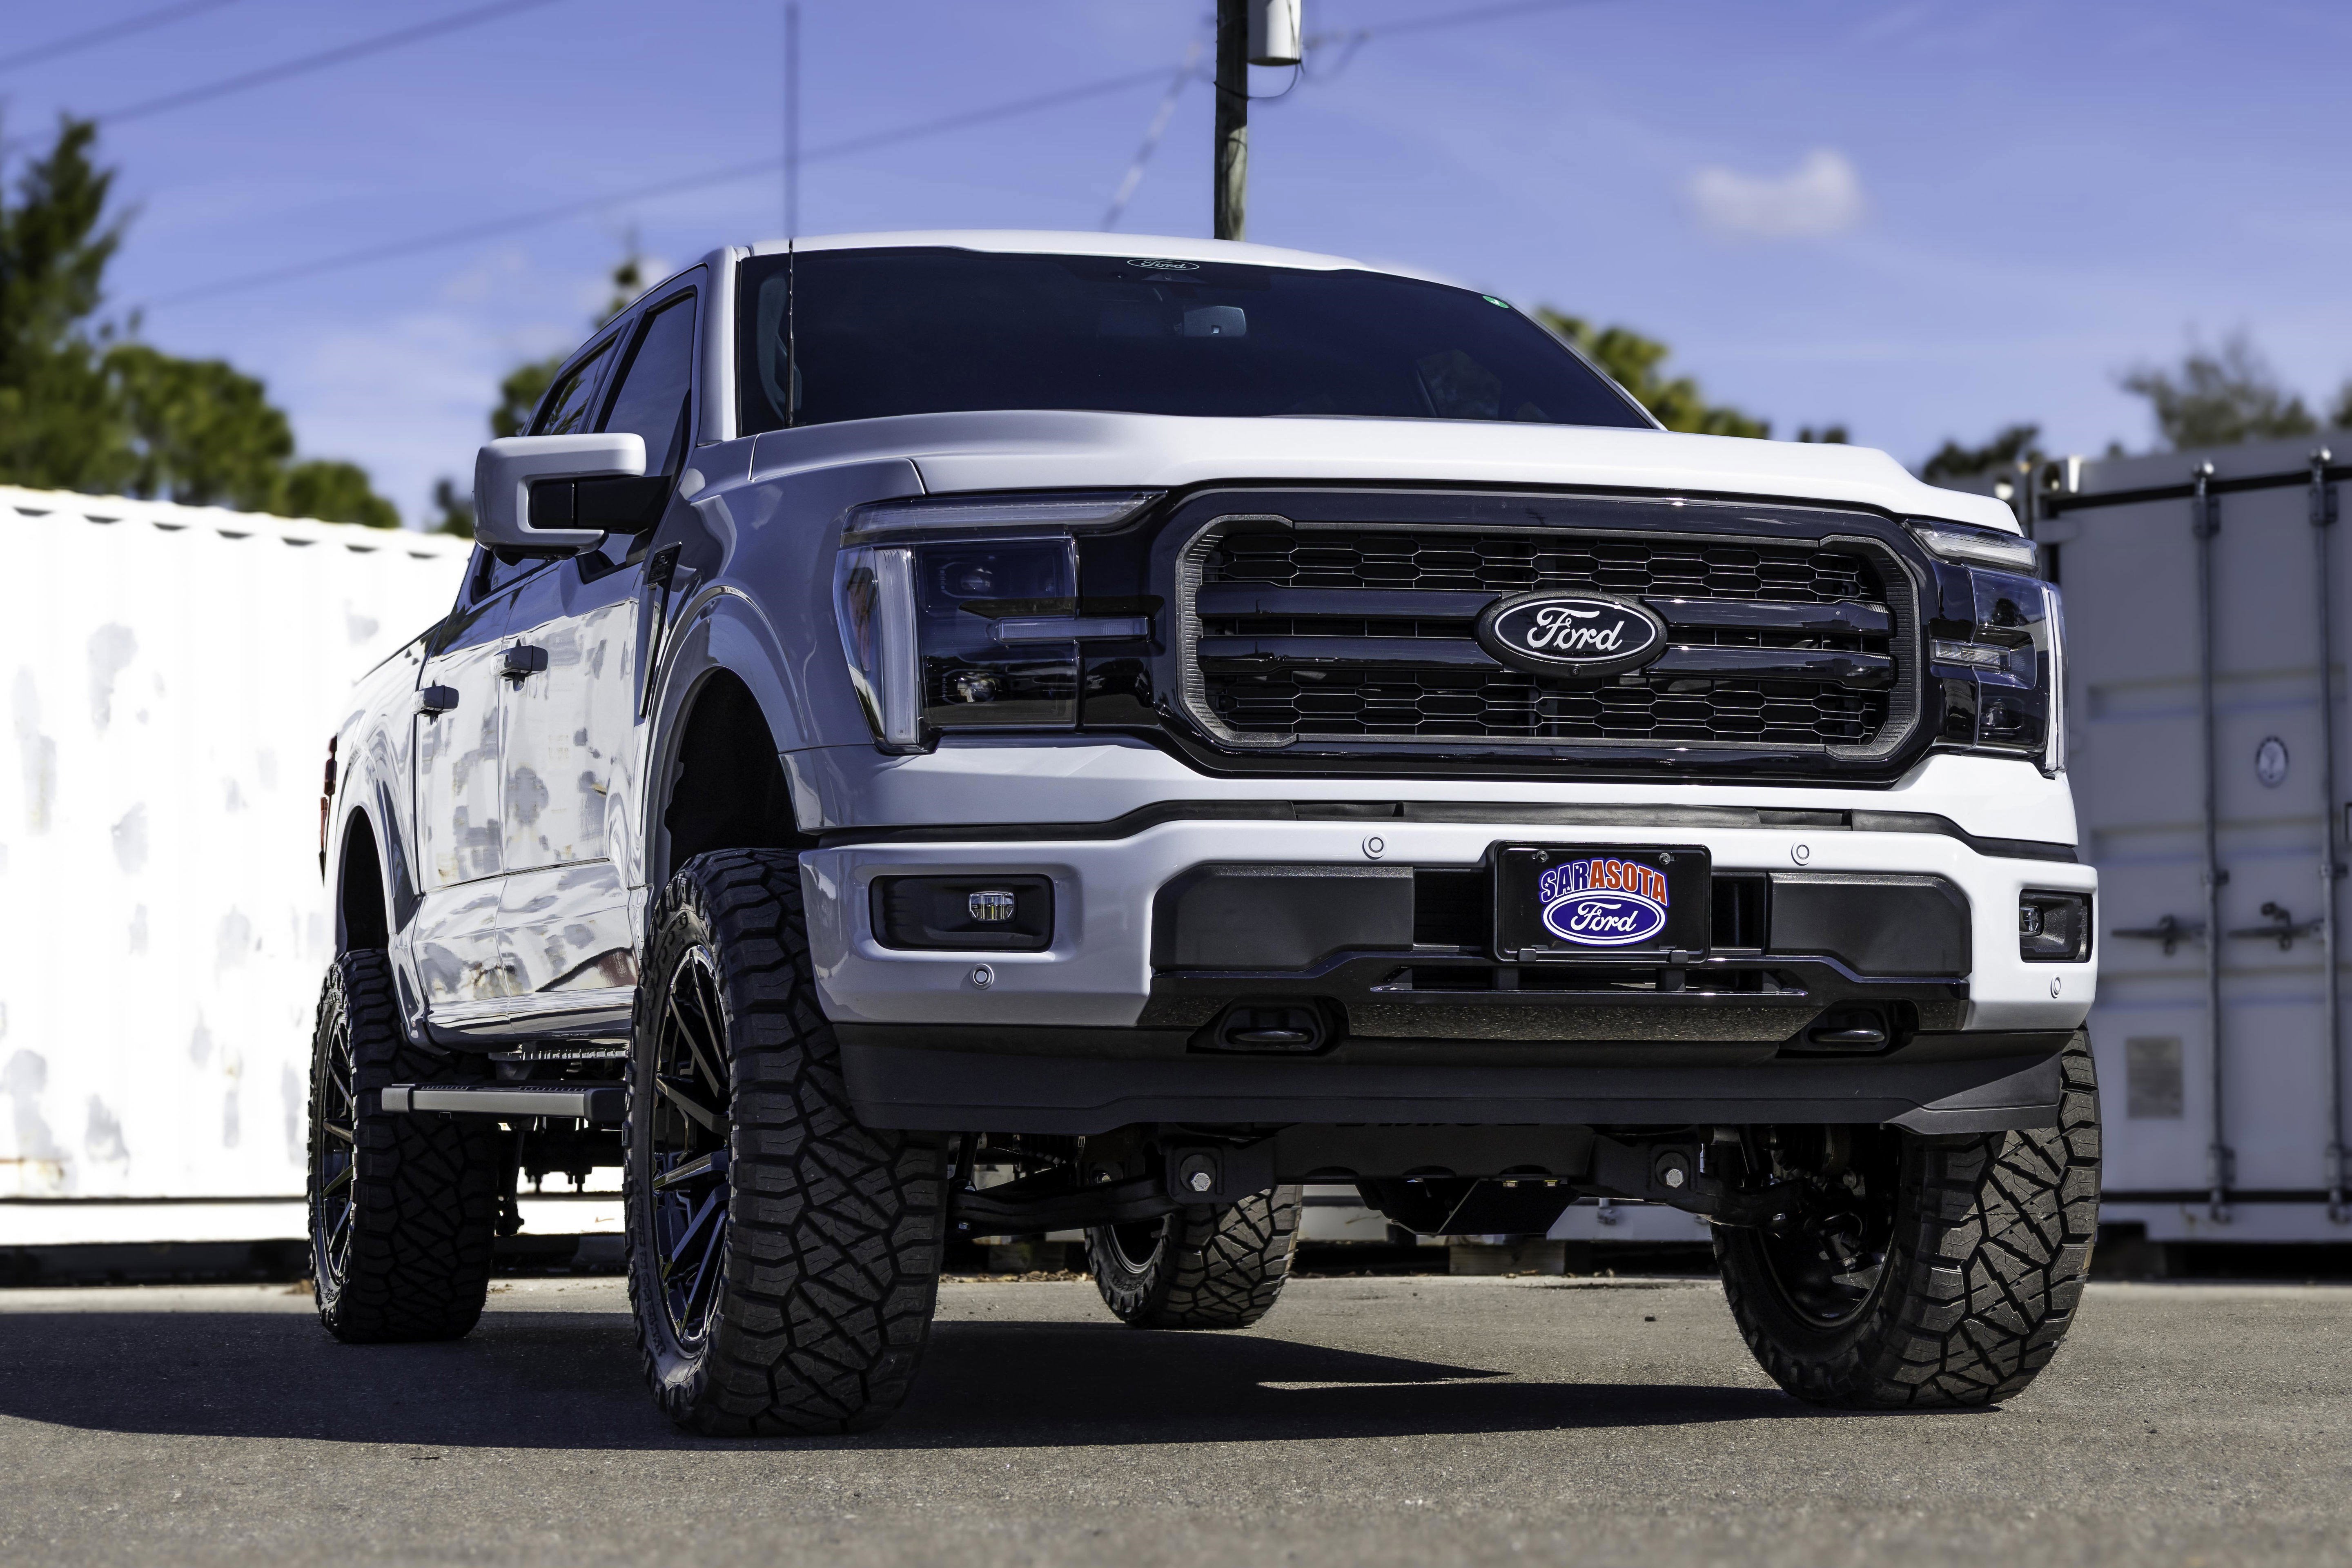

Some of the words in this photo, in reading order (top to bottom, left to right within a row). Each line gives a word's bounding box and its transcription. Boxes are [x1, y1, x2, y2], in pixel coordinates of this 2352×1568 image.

[1141, 260, 1187, 269] Ford
[1527, 607, 1625, 650] Ford
[1541, 860, 1668, 906] SARASOTA
[1570, 901, 1639, 932] Ford
